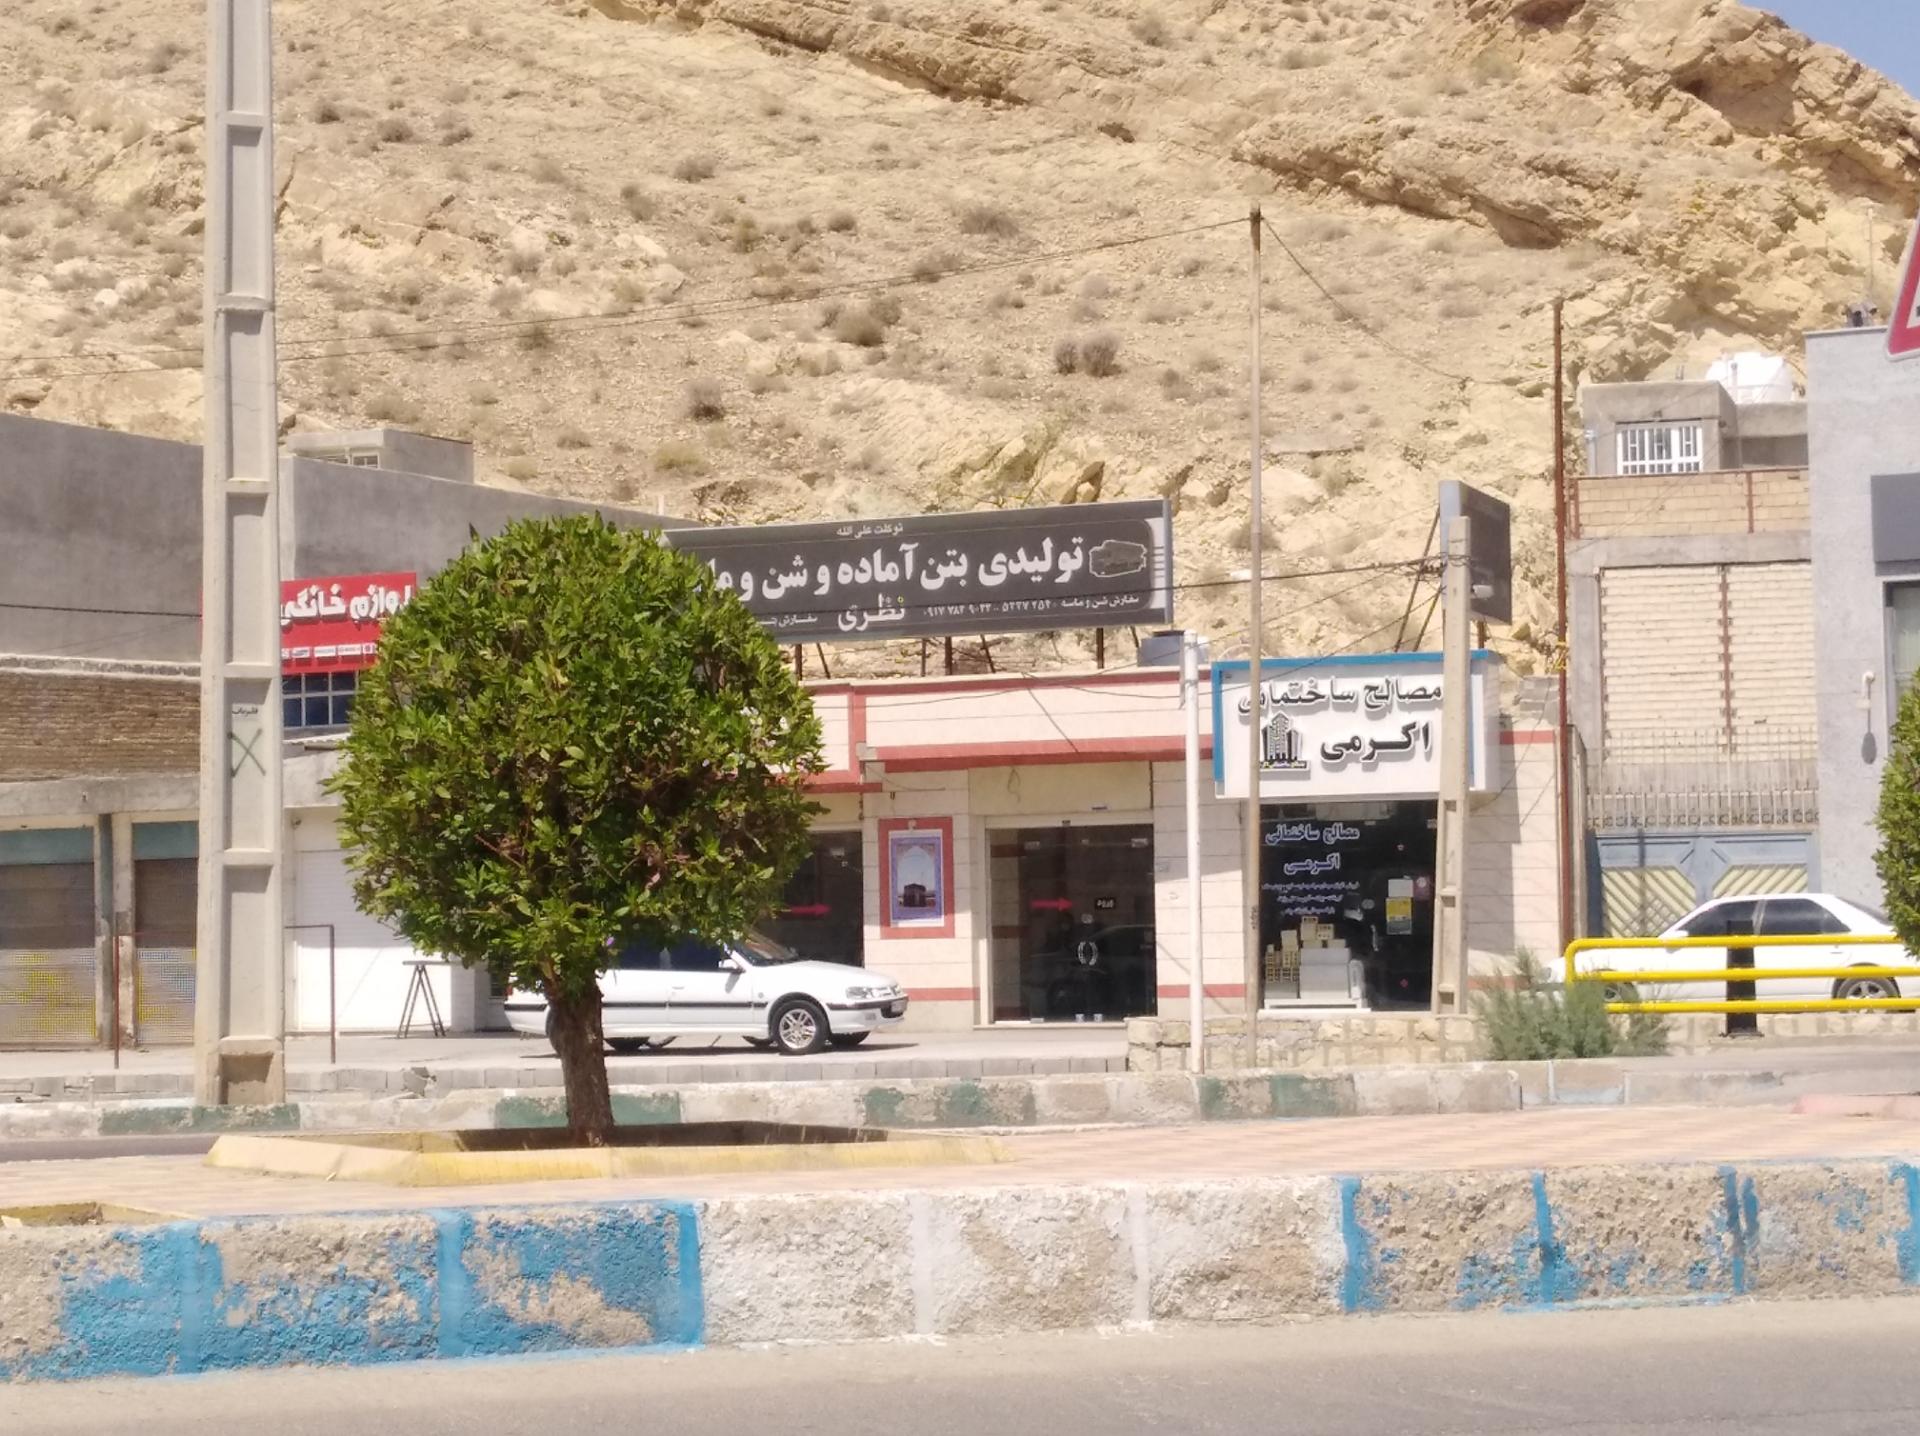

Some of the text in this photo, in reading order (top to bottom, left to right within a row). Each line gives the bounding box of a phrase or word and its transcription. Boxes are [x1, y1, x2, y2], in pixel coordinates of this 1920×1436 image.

[836, 522, 904, 539] توکلت علی الله
[761, 554, 809, 599] شن
[837, 542, 919, 584] آماده
[920, 548, 969, 590] بتن
[978, 536, 1085, 586] تولیدی
[738, 569, 755, 601] و
[813, 563, 830, 596] و
[280, 583, 412, 625] لوازم خانگی
[1060, 597, 1084, 608] ماسه
[1092, 597, 1108, 609] شن
[1109, 594, 1140, 607] سفارش
[1364, 677, 1442, 709] مصالح
[1320, 720, 1430, 761] اکرمی
[1265, 822, 1360, 846] مصالح ساختمانی
[1283, 852, 1341, 876] اکرمی
